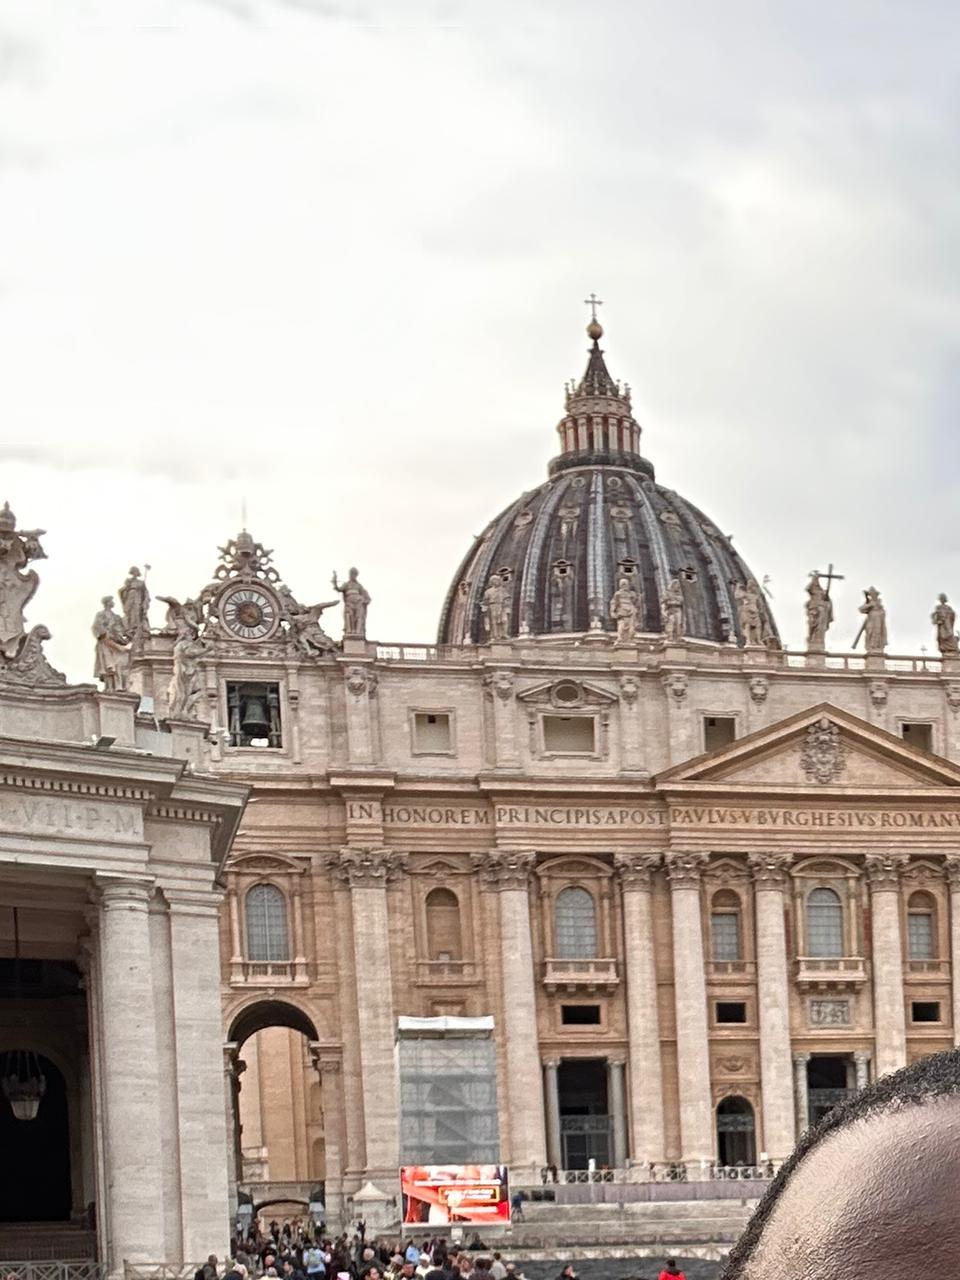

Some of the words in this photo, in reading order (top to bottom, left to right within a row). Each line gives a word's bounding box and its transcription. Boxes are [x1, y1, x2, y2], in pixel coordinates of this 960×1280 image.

[350, 804, 373, 819] IN
[382, 808, 490, 825] HONOREM
[497, 808, 600, 824] PRINCIPIS
[605, 810, 668, 825] APOST
